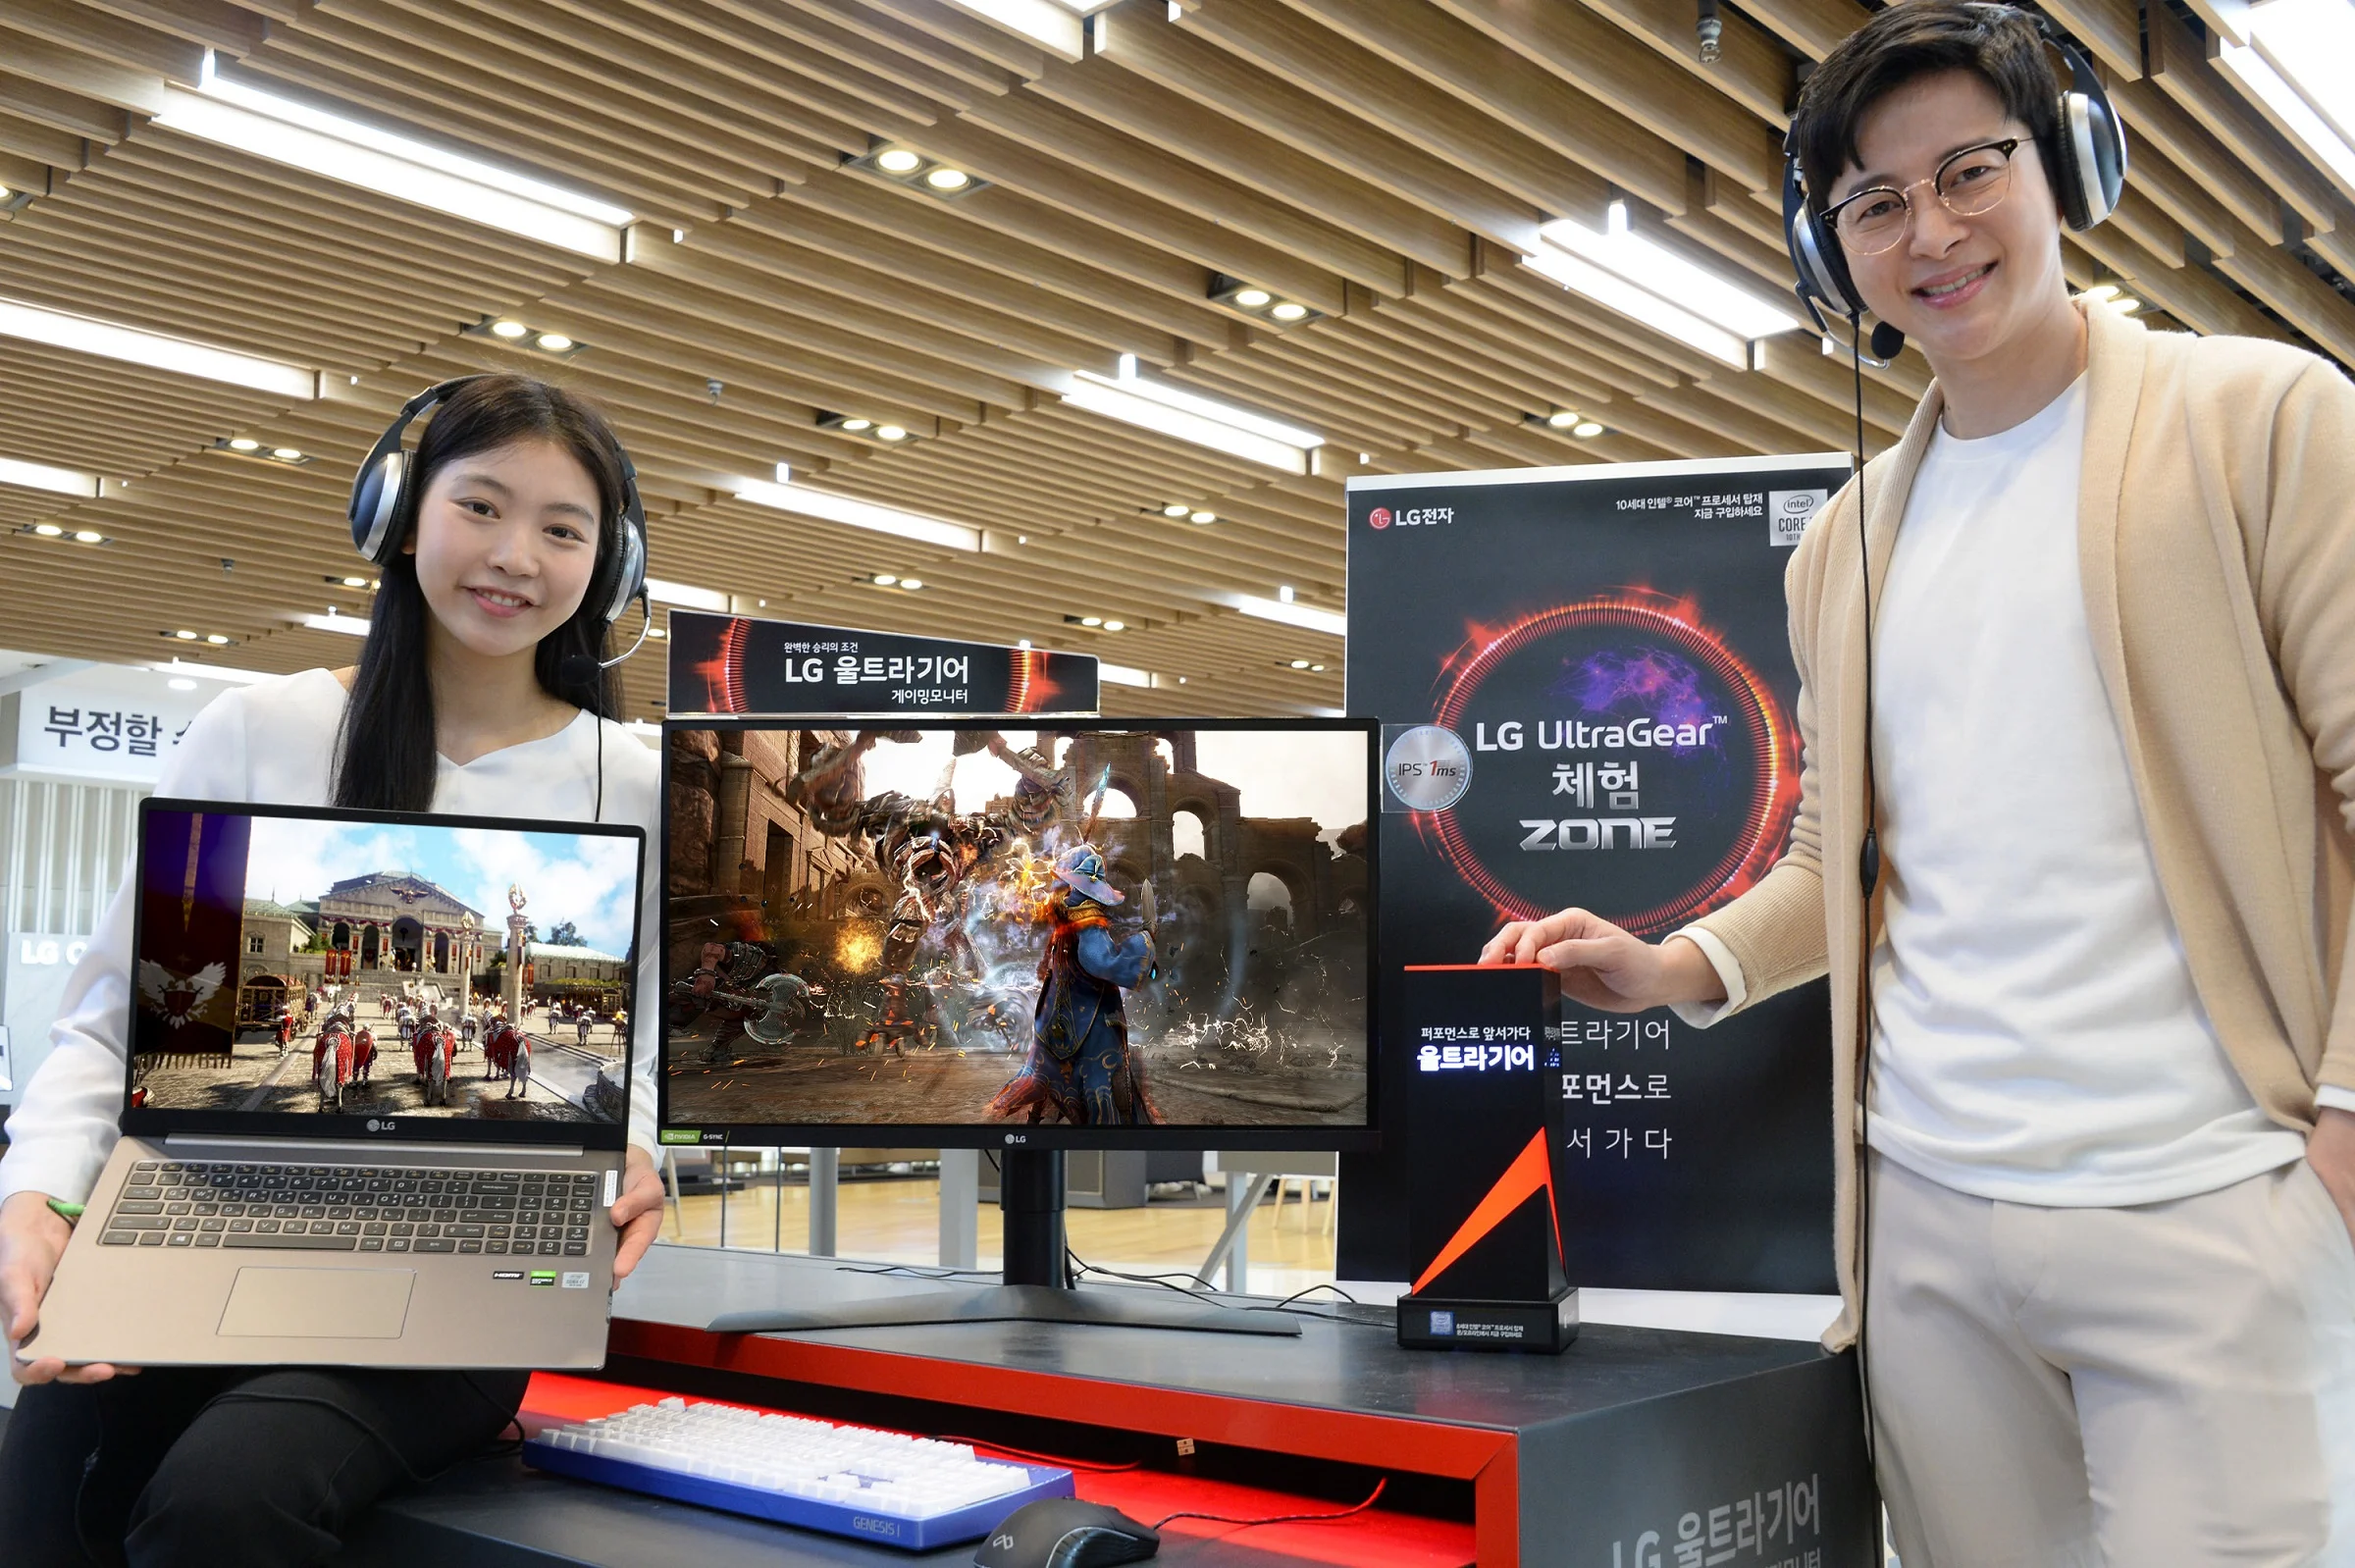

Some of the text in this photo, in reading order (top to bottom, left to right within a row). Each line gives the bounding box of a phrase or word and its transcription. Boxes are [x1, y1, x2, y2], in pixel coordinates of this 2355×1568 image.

[1616, 498, 1646, 510] 10세대
[1701, 493, 1741, 506] 프로세서
[1743, 493, 1763, 504] 탑재
[1695, 505, 1763, 519] 지금 구입하세요
[1787, 498, 1809, 508] intel
[1395, 507, 1454, 526] LG전자
[1778, 517, 1806, 532] CORE
[784, 642, 859, 653] 완벽한 승리의 조건
[785, 655, 968, 685] LG 울트라기어
[891, 689, 968, 705] 게이밍모니터
[44, 706, 163, 757] 부정할
[1476, 721, 1523, 751] LG
[1430, 759, 1457, 776] 1ms
[1551, 760, 1640, 810] 체험
[1519, 816, 1677, 851] ZONE
[21, 939, 59, 965] LG
[1421, 1026, 1480, 1041] 퍼포먼스로
[1483, 1026, 1531, 1041] 앞서가다
[1561, 1019, 1670, 1050] 트라기어
[1417, 1044, 1535, 1071] 울트라기어
[1562, 1072, 1672, 1105] 포먼스로
[381, 1121, 395, 1130] LG
[854, 1515, 895, 1536] GENESIS
[1673, 1473, 1820, 1568] 울트라기어
